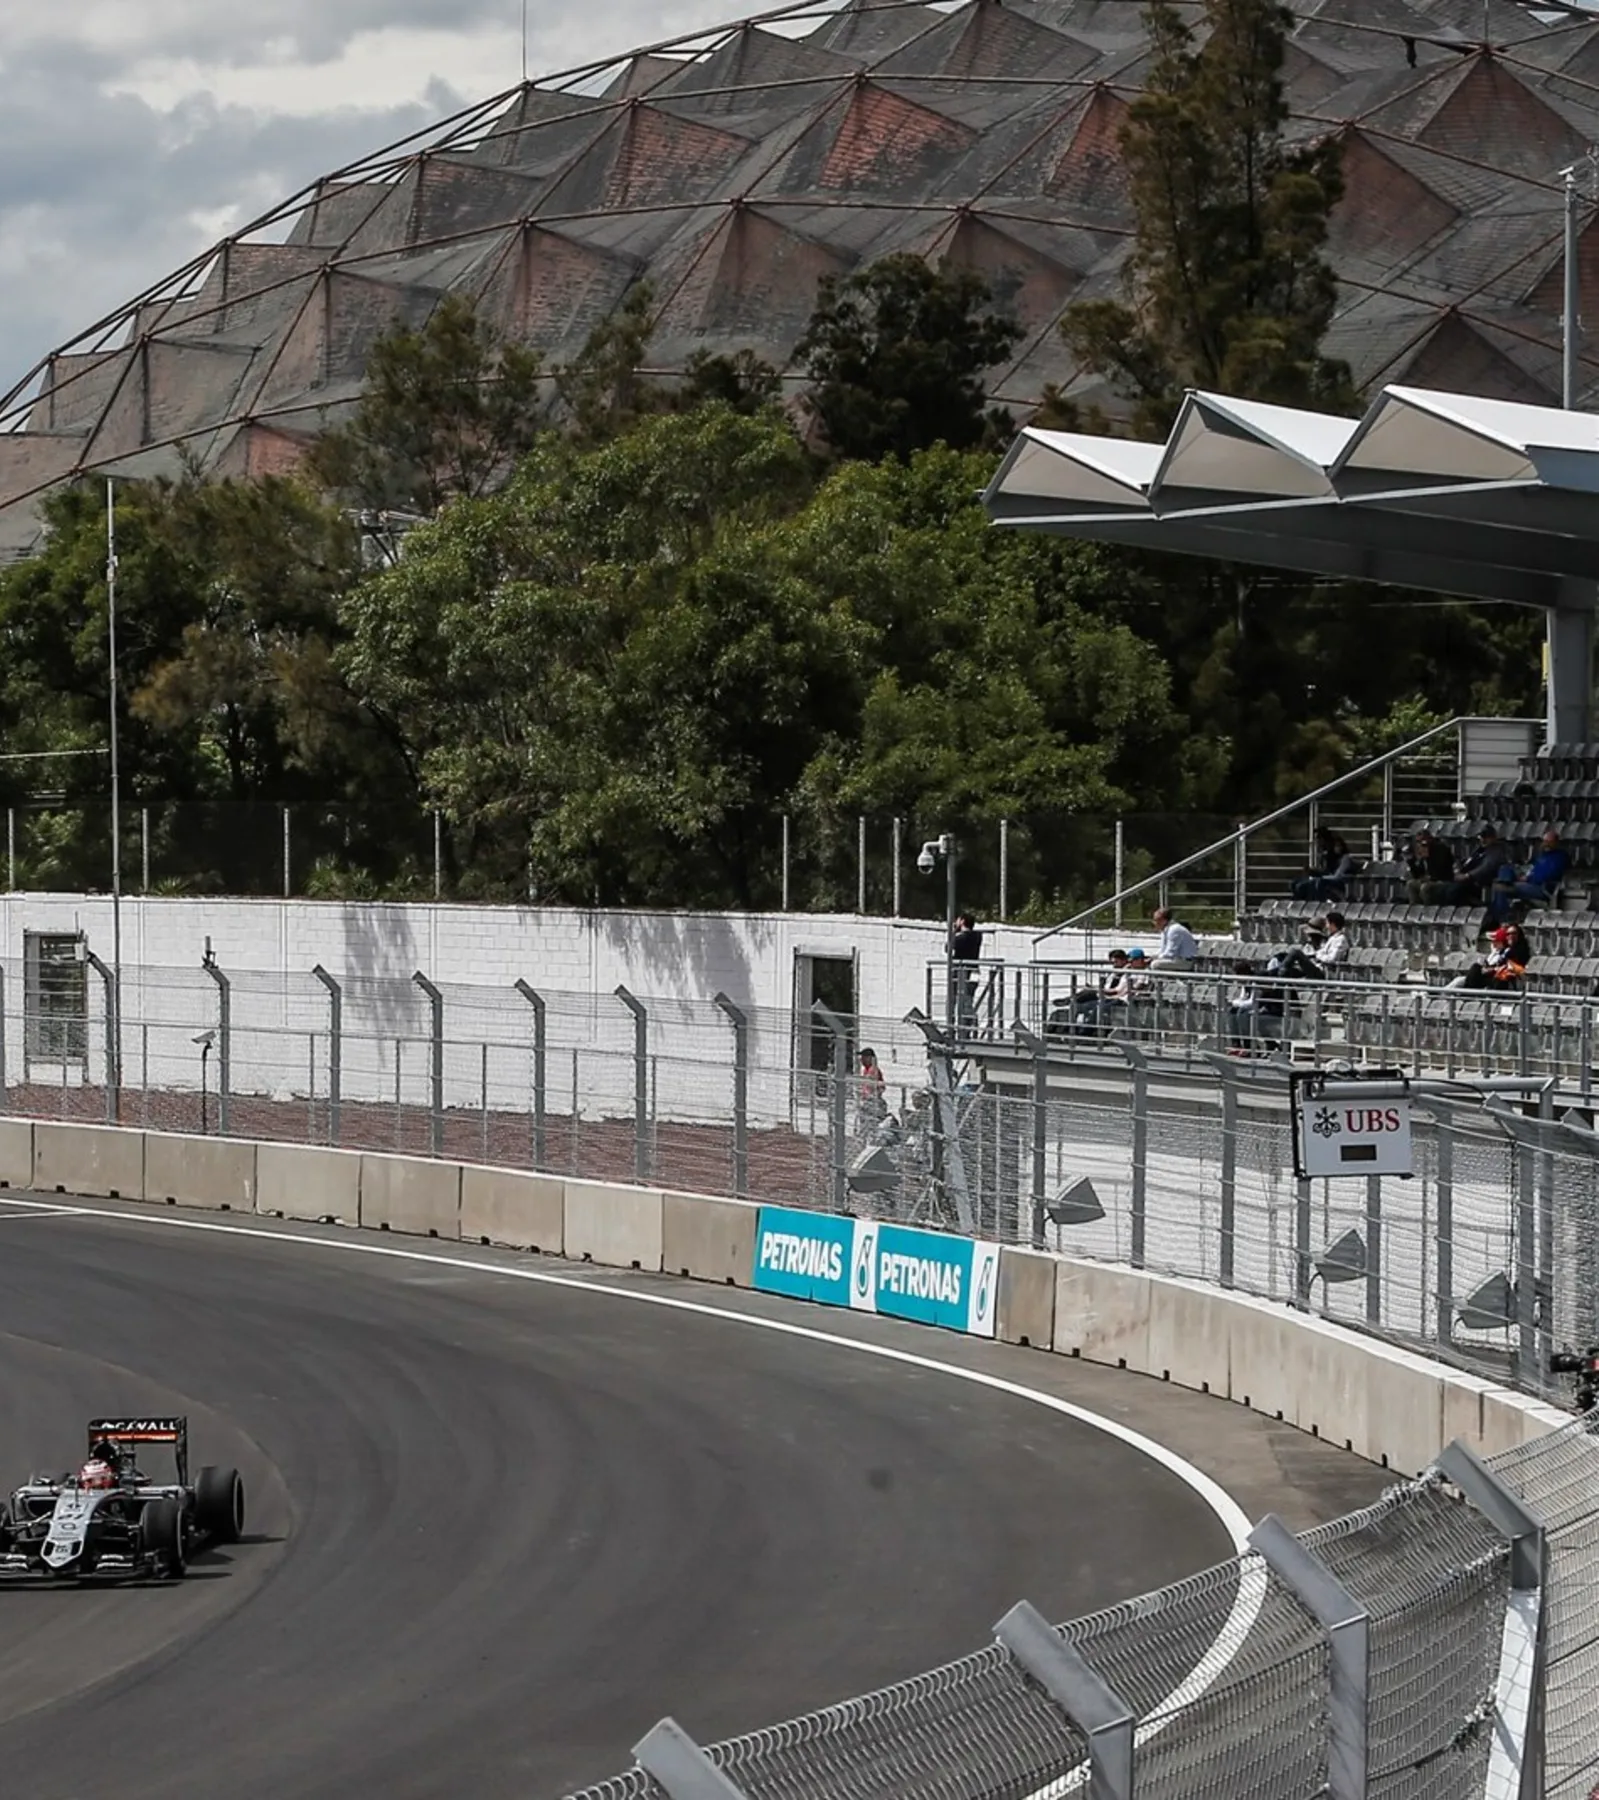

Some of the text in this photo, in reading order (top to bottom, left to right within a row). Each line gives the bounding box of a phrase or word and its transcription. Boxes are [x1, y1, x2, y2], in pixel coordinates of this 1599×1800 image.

[1344, 1107, 1400, 1133] UBS
[760, 1231, 843, 1282] PETRONAS
[879, 1251, 962, 1305] PETRONAS
